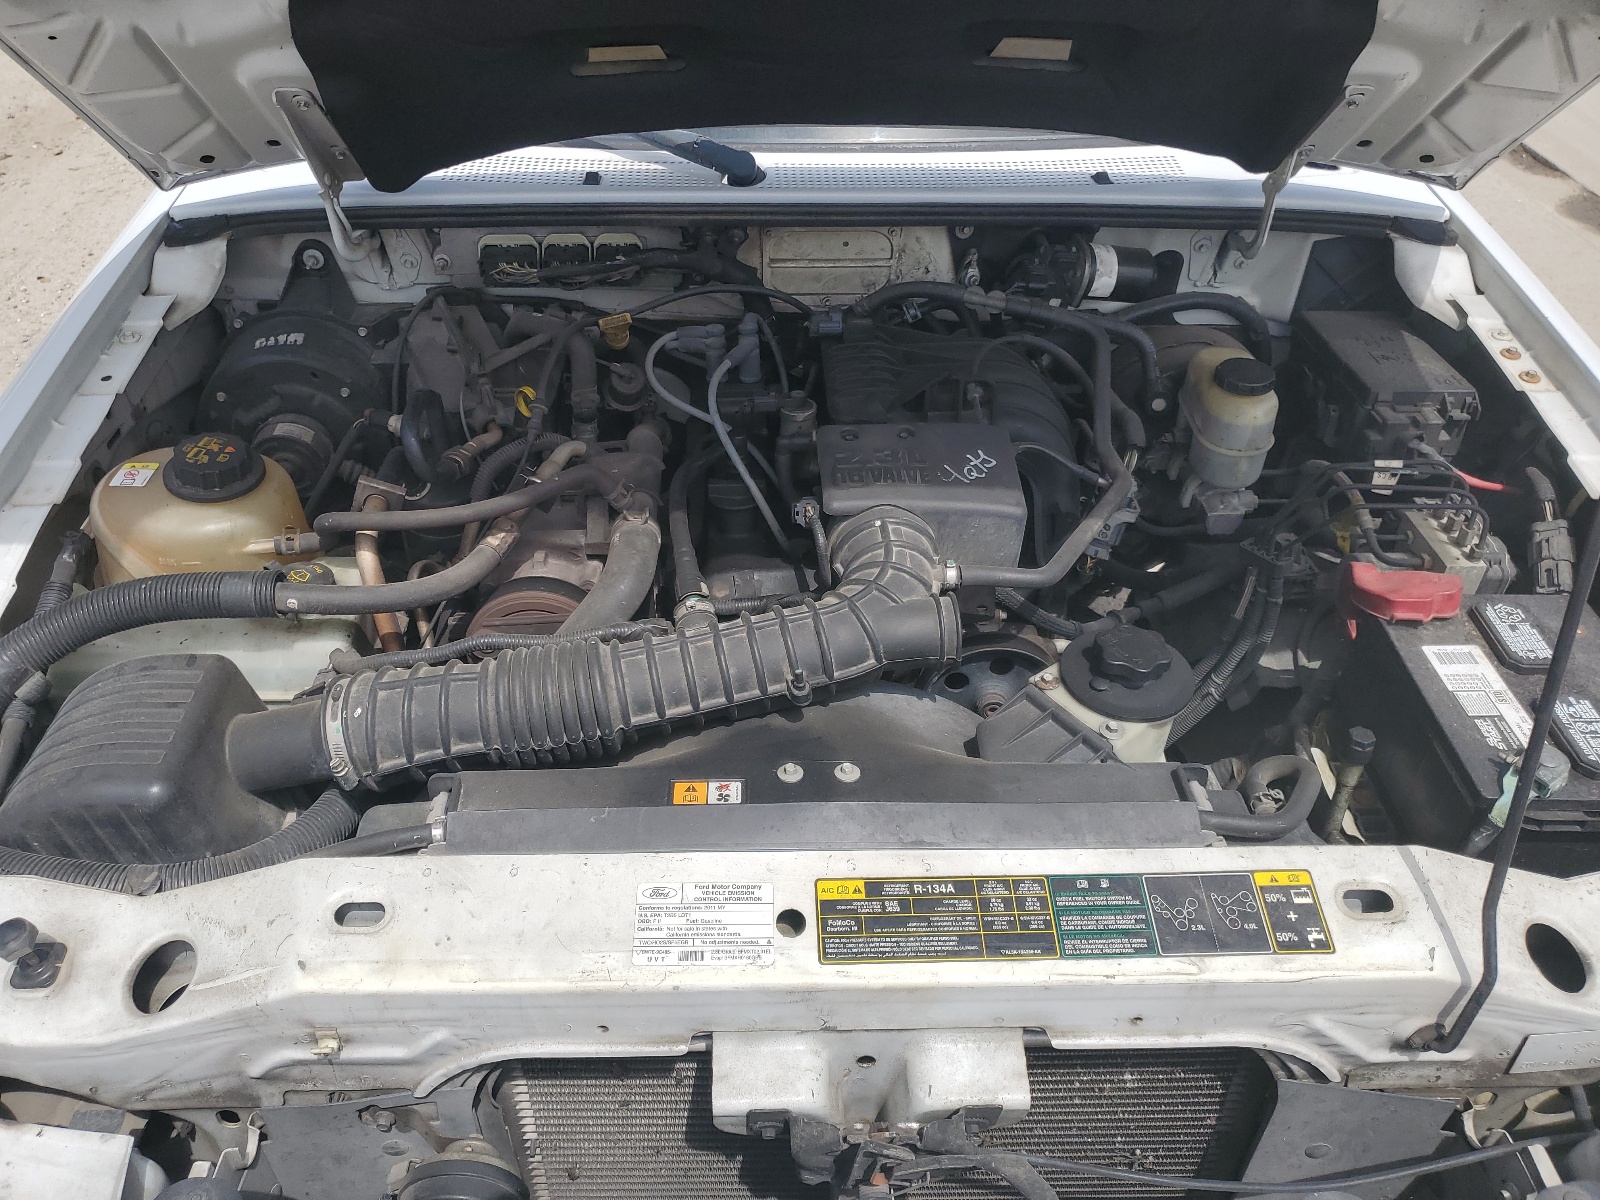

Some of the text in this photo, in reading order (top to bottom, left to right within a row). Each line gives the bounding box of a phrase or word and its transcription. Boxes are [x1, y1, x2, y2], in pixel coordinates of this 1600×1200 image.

[868, 468, 930, 485] VALVE
[649, 888, 670, 898] Ford
[914, 884, 956, 894] R-134A
[1264, 894, 1286, 902] 50%
[1276, 932, 1298, 942] 50%
